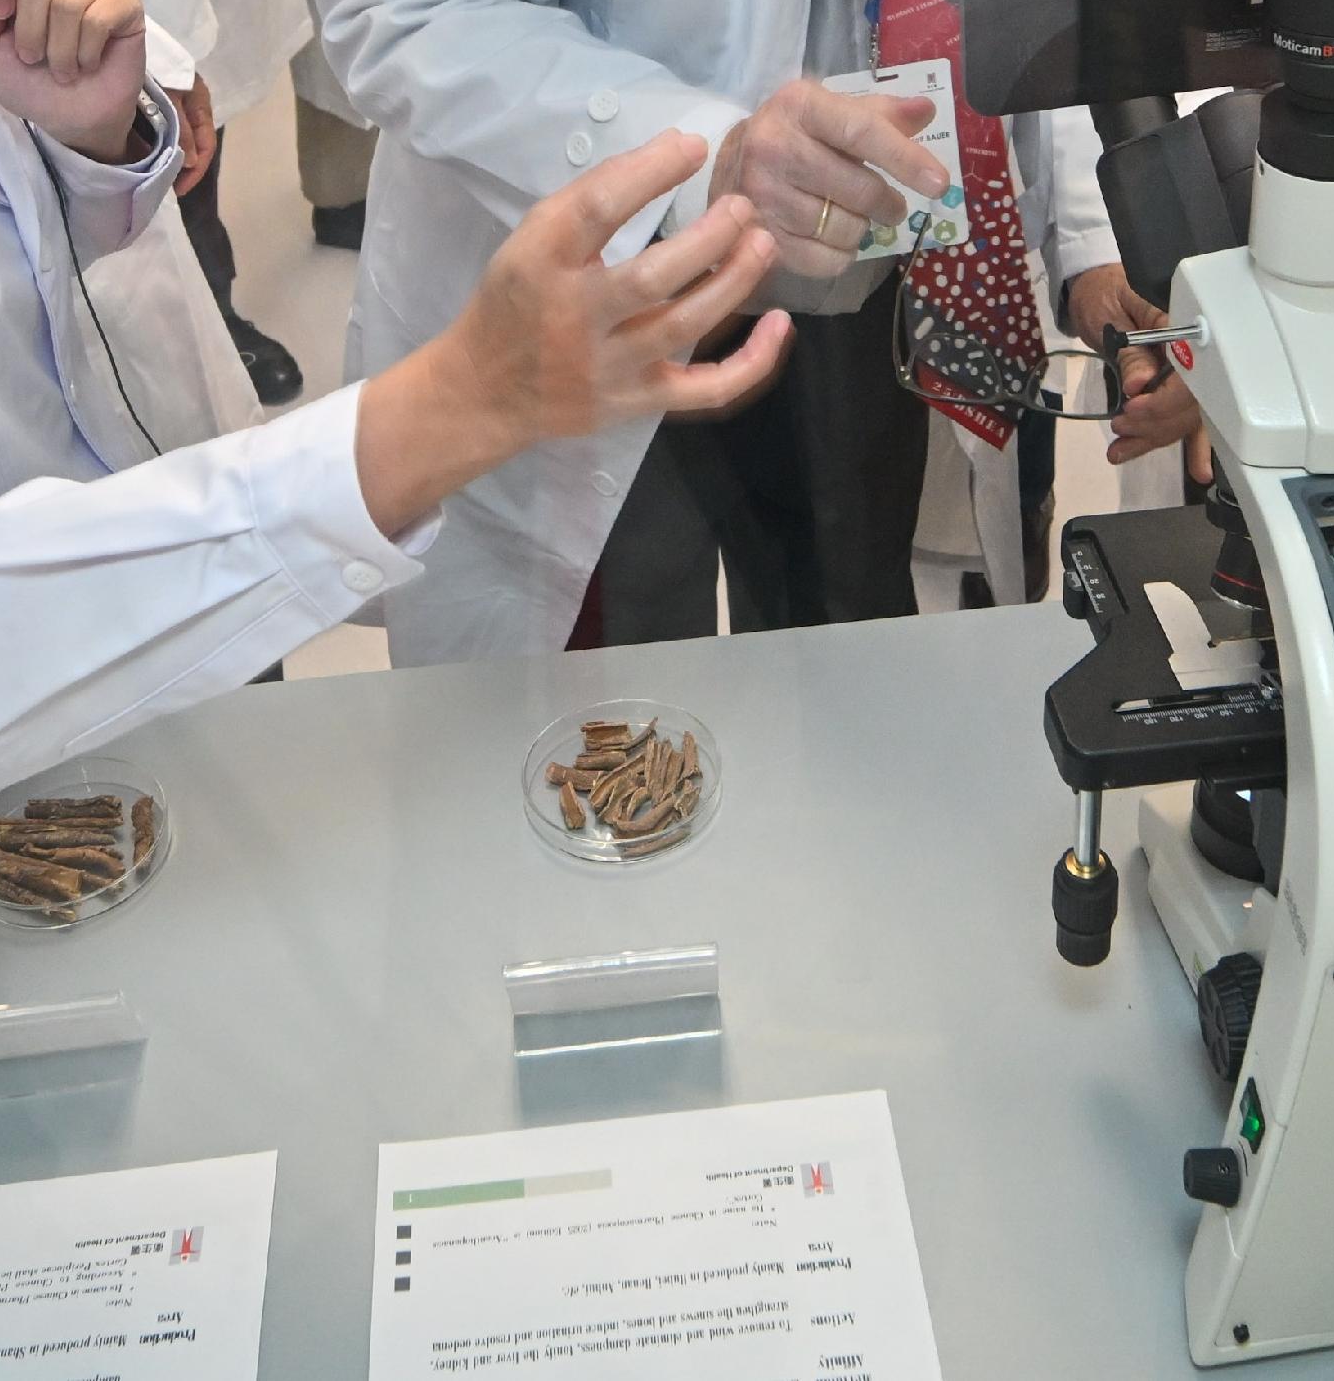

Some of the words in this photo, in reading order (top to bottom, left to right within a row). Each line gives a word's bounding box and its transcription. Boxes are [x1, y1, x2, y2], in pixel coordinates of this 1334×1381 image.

[705, 1172, 732, 1182] Health
[733, 1171, 743, 1179] of
[744, 1164, 794, 1176] Department
[75, 1240, 102, 1250] Health
[103, 1238, 113, 1247] of
[115, 1230, 166, 1245] Department
[130, 1243, 164, 1256] 衛生署
[808, 1241, 834, 1254] Area
[703, 1263, 749, 1283] produced
[751, 1260, 784, 1276] Mainly
[796, 1257, 852, 1274] Production
[15, 1276, 53, 1290] Chinese
[75, 1269, 125, 1284] According
[655, 1272, 687, 1288] Hubei,
[690, 1271, 700, 1284] in
[34, 1290, 68, 1303] Chinese
[561, 1285, 579, 1299] etc.
[717, 1308, 732, 1321] the
[735, 1300, 789, 1318] strengthen
[157, 1311, 184, 1324] Area
[622, 1316, 655, 1331] bones,
[659, 1314, 677, 1329] and
[680, 1311, 714, 1325] sinews
[778, 1318, 793, 1332] To
[810, 1311, 857, 1329] Actions
[536, 1325, 583, 1341] urination
[585, 1320, 618, 1336] induce
[709, 1324, 734, 1340] wind
[738, 1320, 776, 1335] remove
[92, 1333, 128, 1350] Mainly
[139, 1329, 197, 1348] Production
[474, 1334, 511, 1349] resolve
[514, 1331, 533, 1345] and
[635, 1332, 682, 1348] eliminate
[686, 1329, 705, 1344] and
[29, 1344, 40, 1358] in
[42, 1336, 91, 1357] produced
[432, 1339, 471, 1353] oedema
[544, 1343, 573, 1361] tonify
[577, 1336, 631, 1355] dampness,
[473, 1355, 492, 1370] and
[496, 1351, 519, 1365] liver
[523, 1349, 539, 1363] the
[818, 1353, 864, 1370] Affinity
[429, 1356, 468, 1373] kidney,
